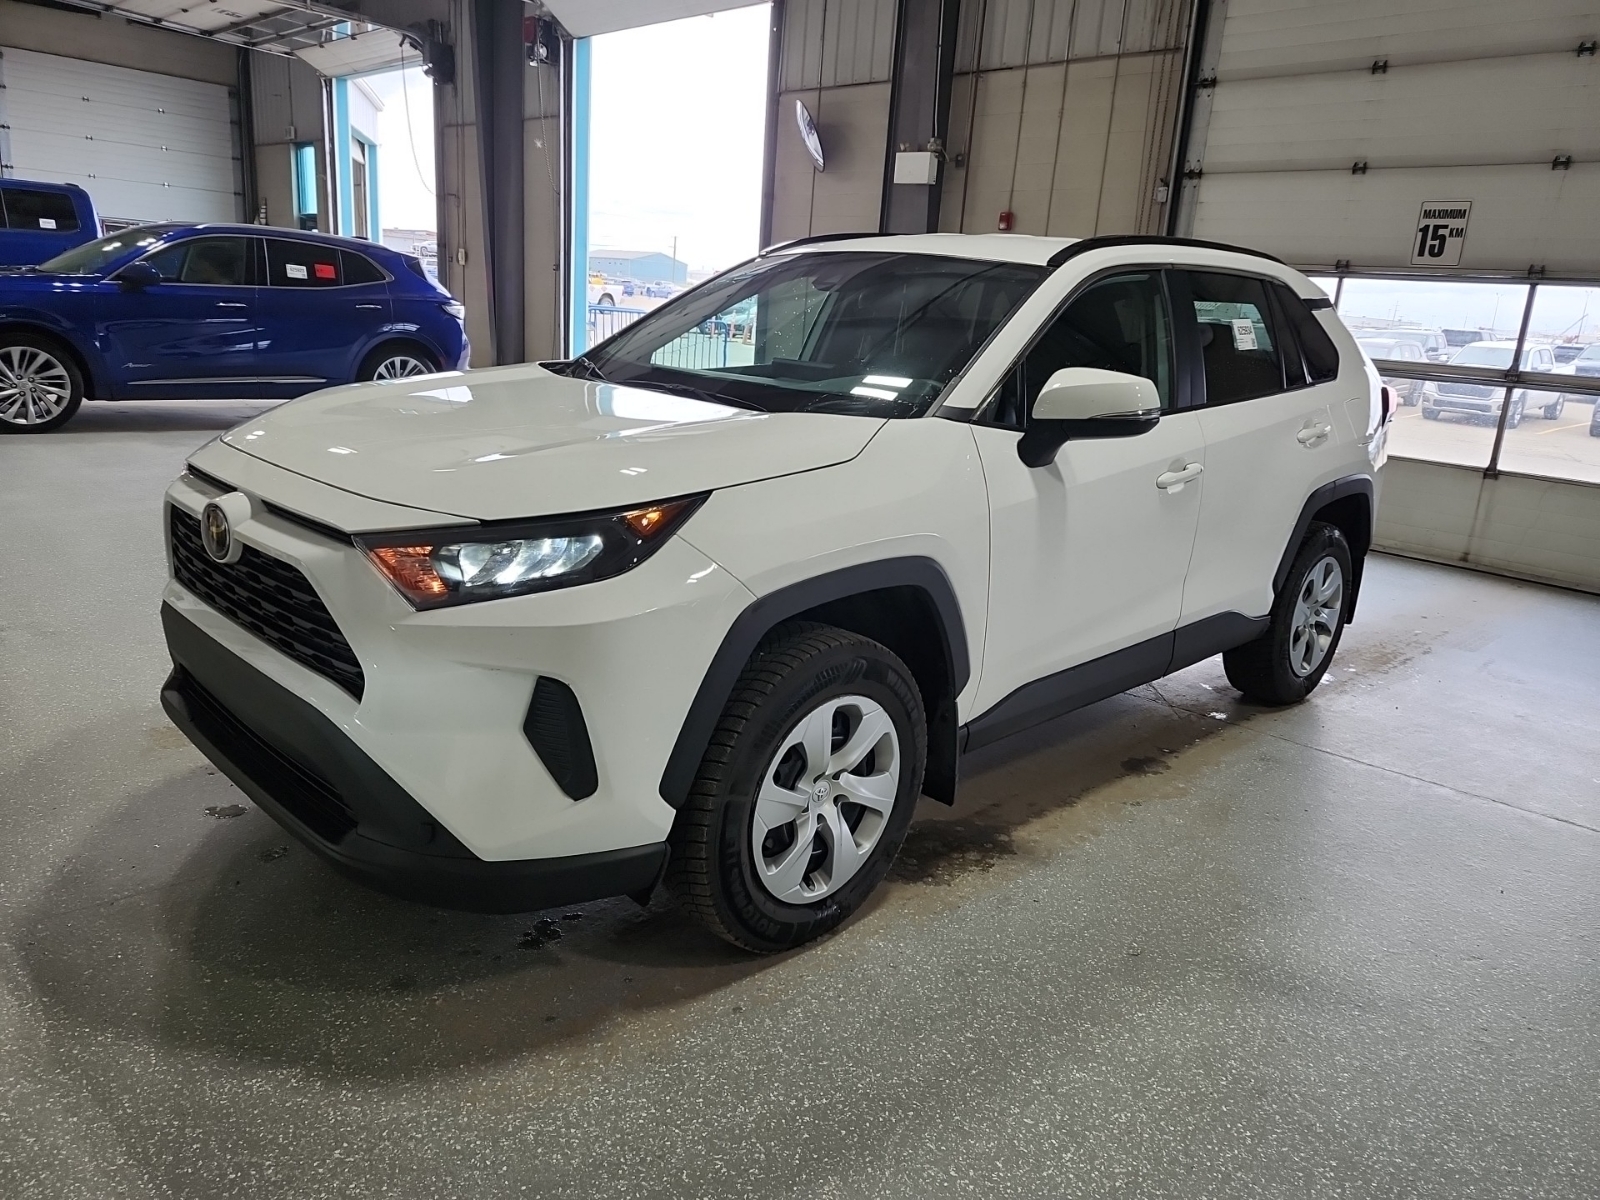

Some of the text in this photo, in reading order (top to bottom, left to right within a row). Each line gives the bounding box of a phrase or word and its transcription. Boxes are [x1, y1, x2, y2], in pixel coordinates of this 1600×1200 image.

[1422, 209, 1467, 219] MAXIMUM
[1417, 224, 1464, 258] 15 KM
